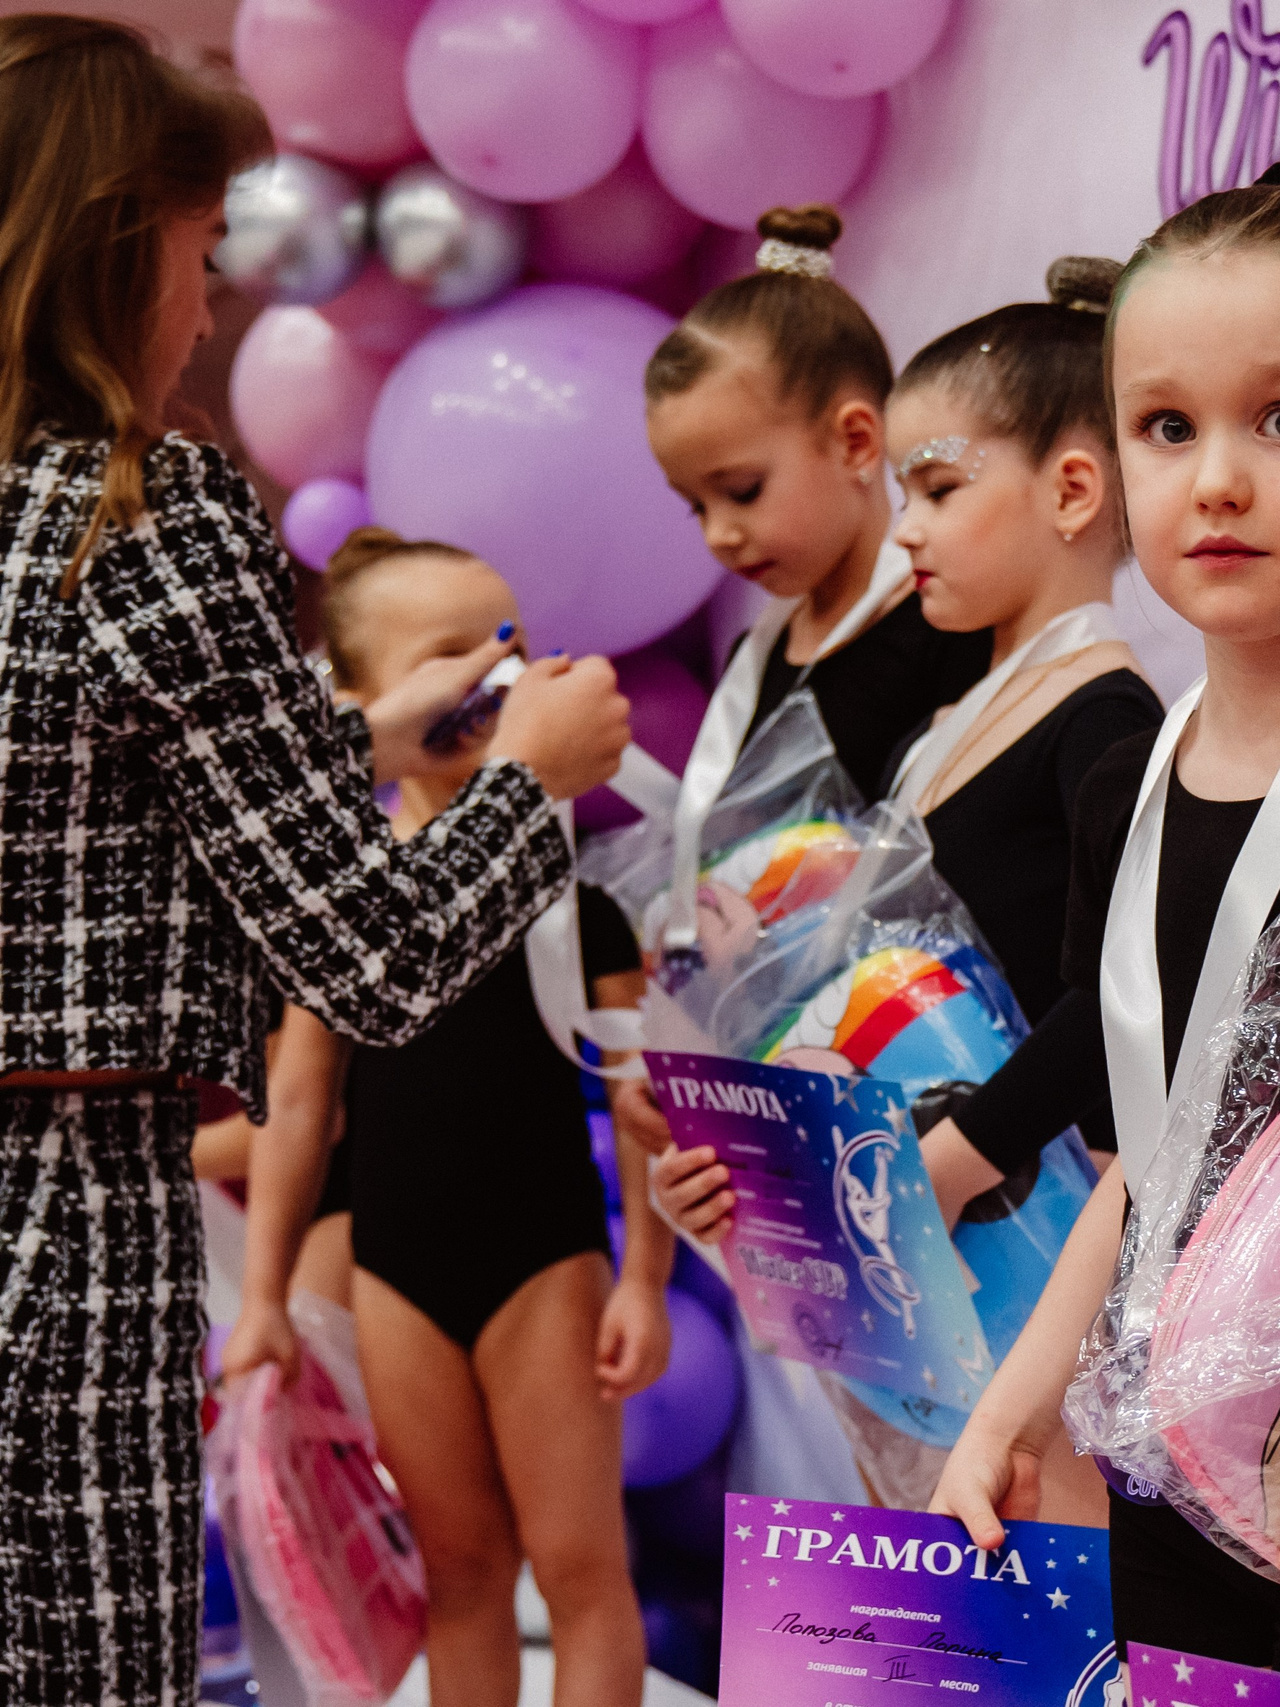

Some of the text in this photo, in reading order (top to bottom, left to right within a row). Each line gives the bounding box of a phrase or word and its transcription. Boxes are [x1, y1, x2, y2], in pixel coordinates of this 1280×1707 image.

[668, 1075, 788, 1123] ГРАМОТА
[761, 1525, 1031, 1585] ГРАМОТА
[850, 1604, 942, 1623] награждается
[806, 1661, 868, 1677] занявшая
[939, 1679, 980, 1693] место
